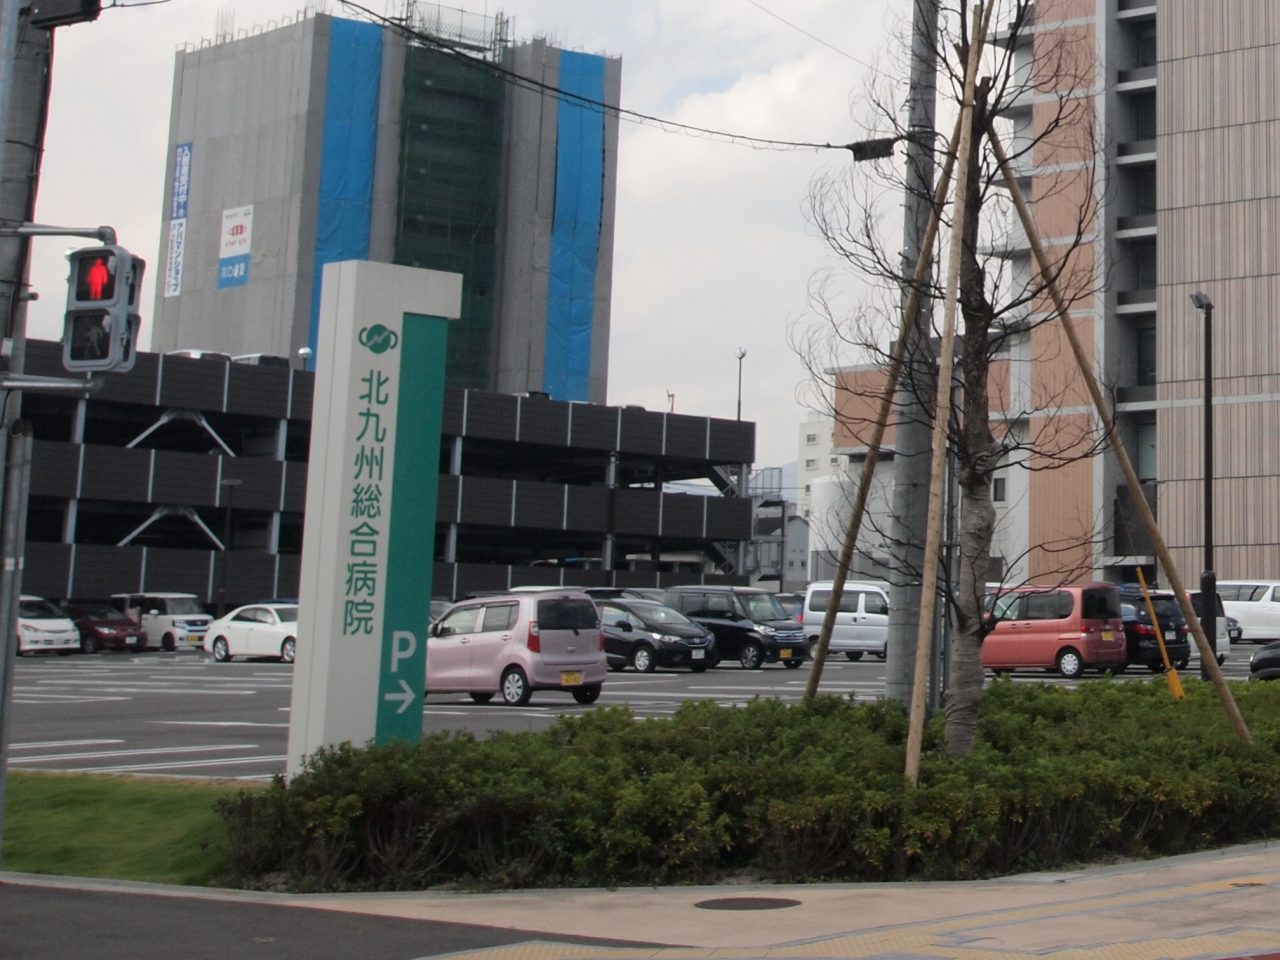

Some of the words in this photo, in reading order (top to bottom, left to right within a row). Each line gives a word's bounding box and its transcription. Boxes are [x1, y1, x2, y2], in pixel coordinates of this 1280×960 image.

[343, 369, 389, 636] 北九州総合病院
[390, 630, 417, 673] P
